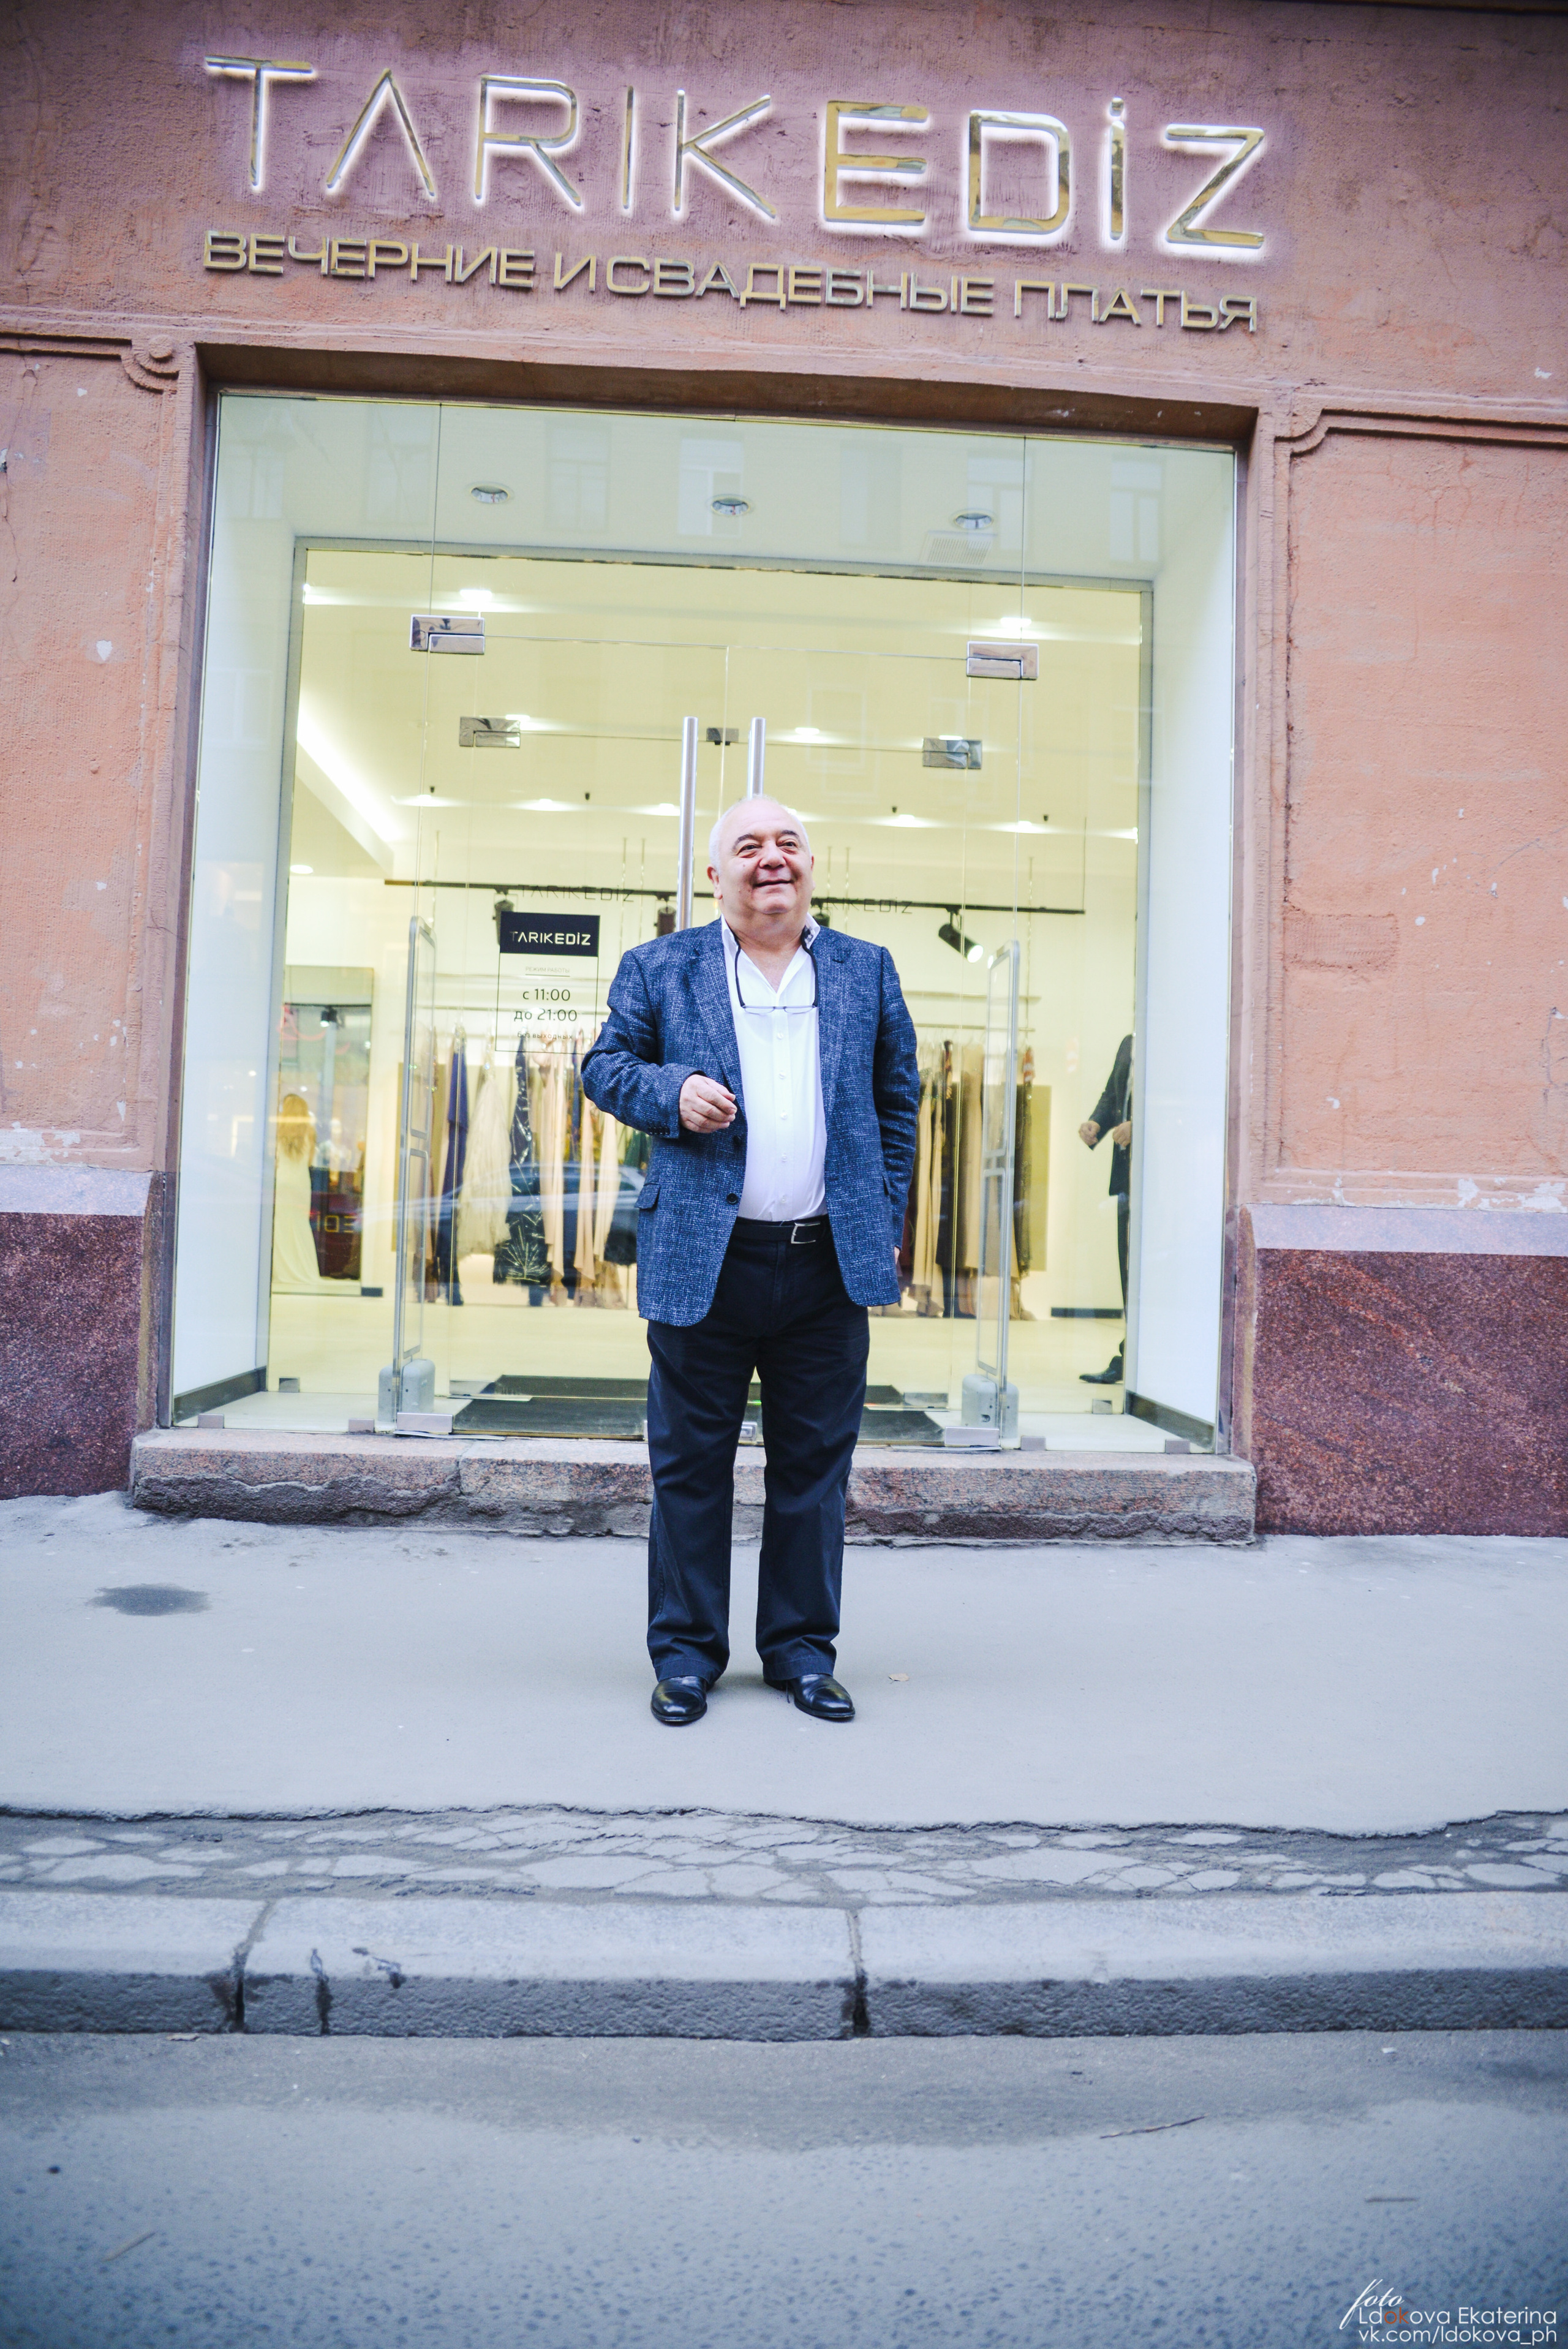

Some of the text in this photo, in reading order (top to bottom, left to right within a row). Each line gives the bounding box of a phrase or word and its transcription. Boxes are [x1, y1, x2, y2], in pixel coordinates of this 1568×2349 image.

[203, 230, 535, 290] ВЕЧЕРНИЕ
[1014, 279, 1258, 333] ПЛАТЬЯ
[535, 989, 571, 1001] 11:00
[514, 1009, 577, 1022] до 21:00
